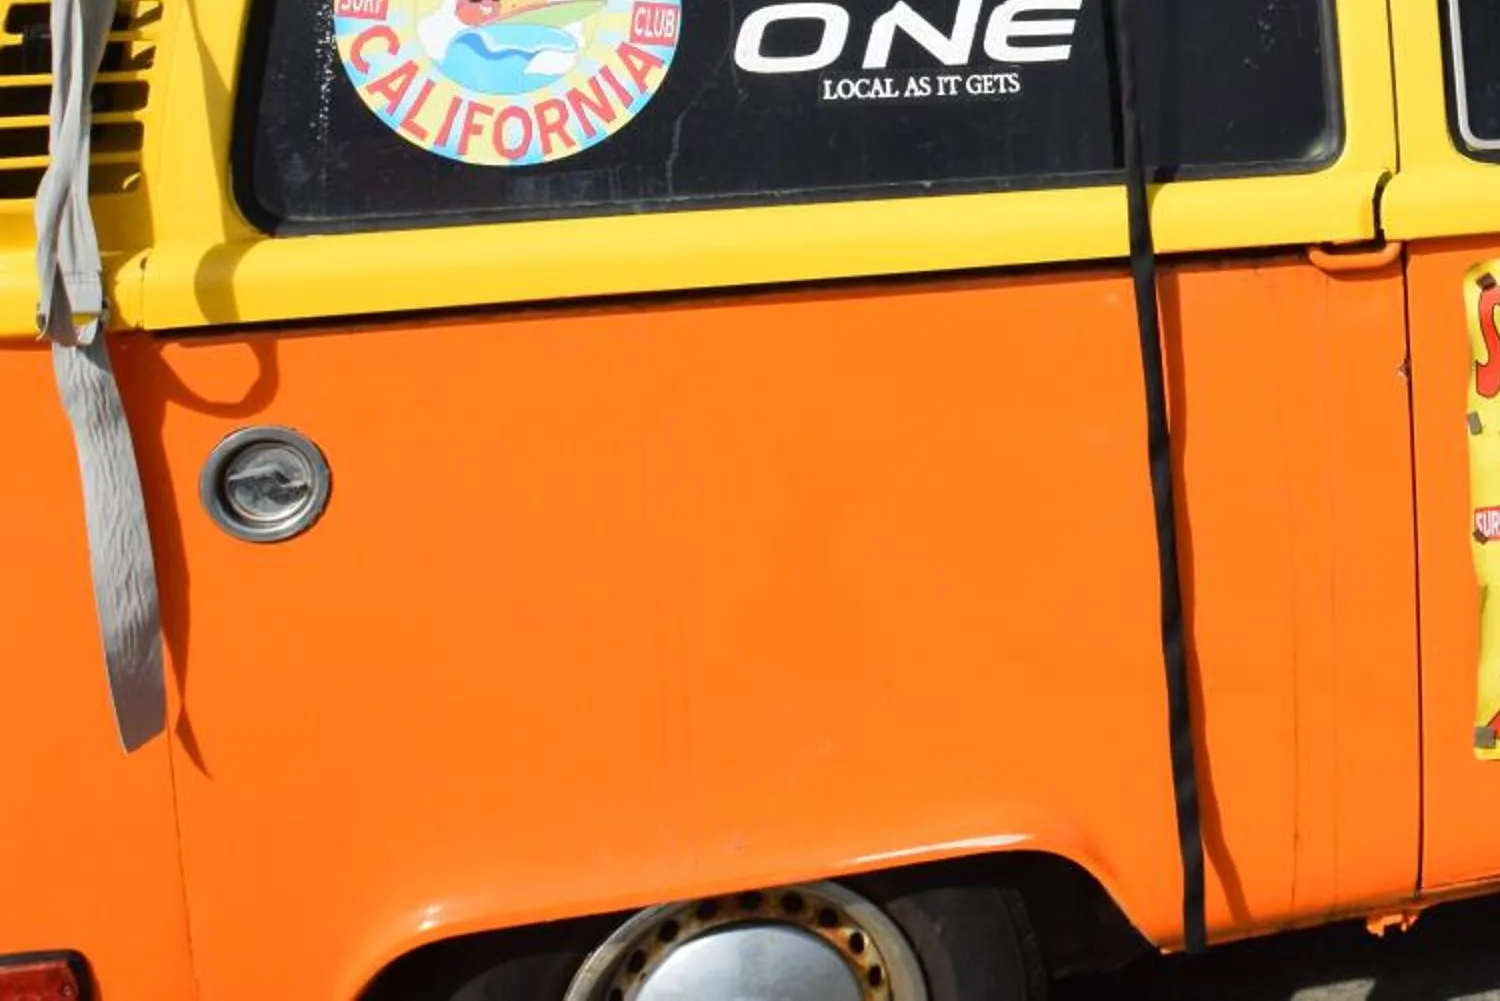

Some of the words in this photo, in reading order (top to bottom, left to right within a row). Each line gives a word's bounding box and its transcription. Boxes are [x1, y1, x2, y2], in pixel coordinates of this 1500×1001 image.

[633, 8, 677, 40] CLUB
[350, 25, 665, 161] CALIFORNIA
[823, 76, 899, 100] LOCAL
[904, 76, 931, 97] AS
[937, 75, 964, 96] IT
[965, 72, 1021, 95] GETS
